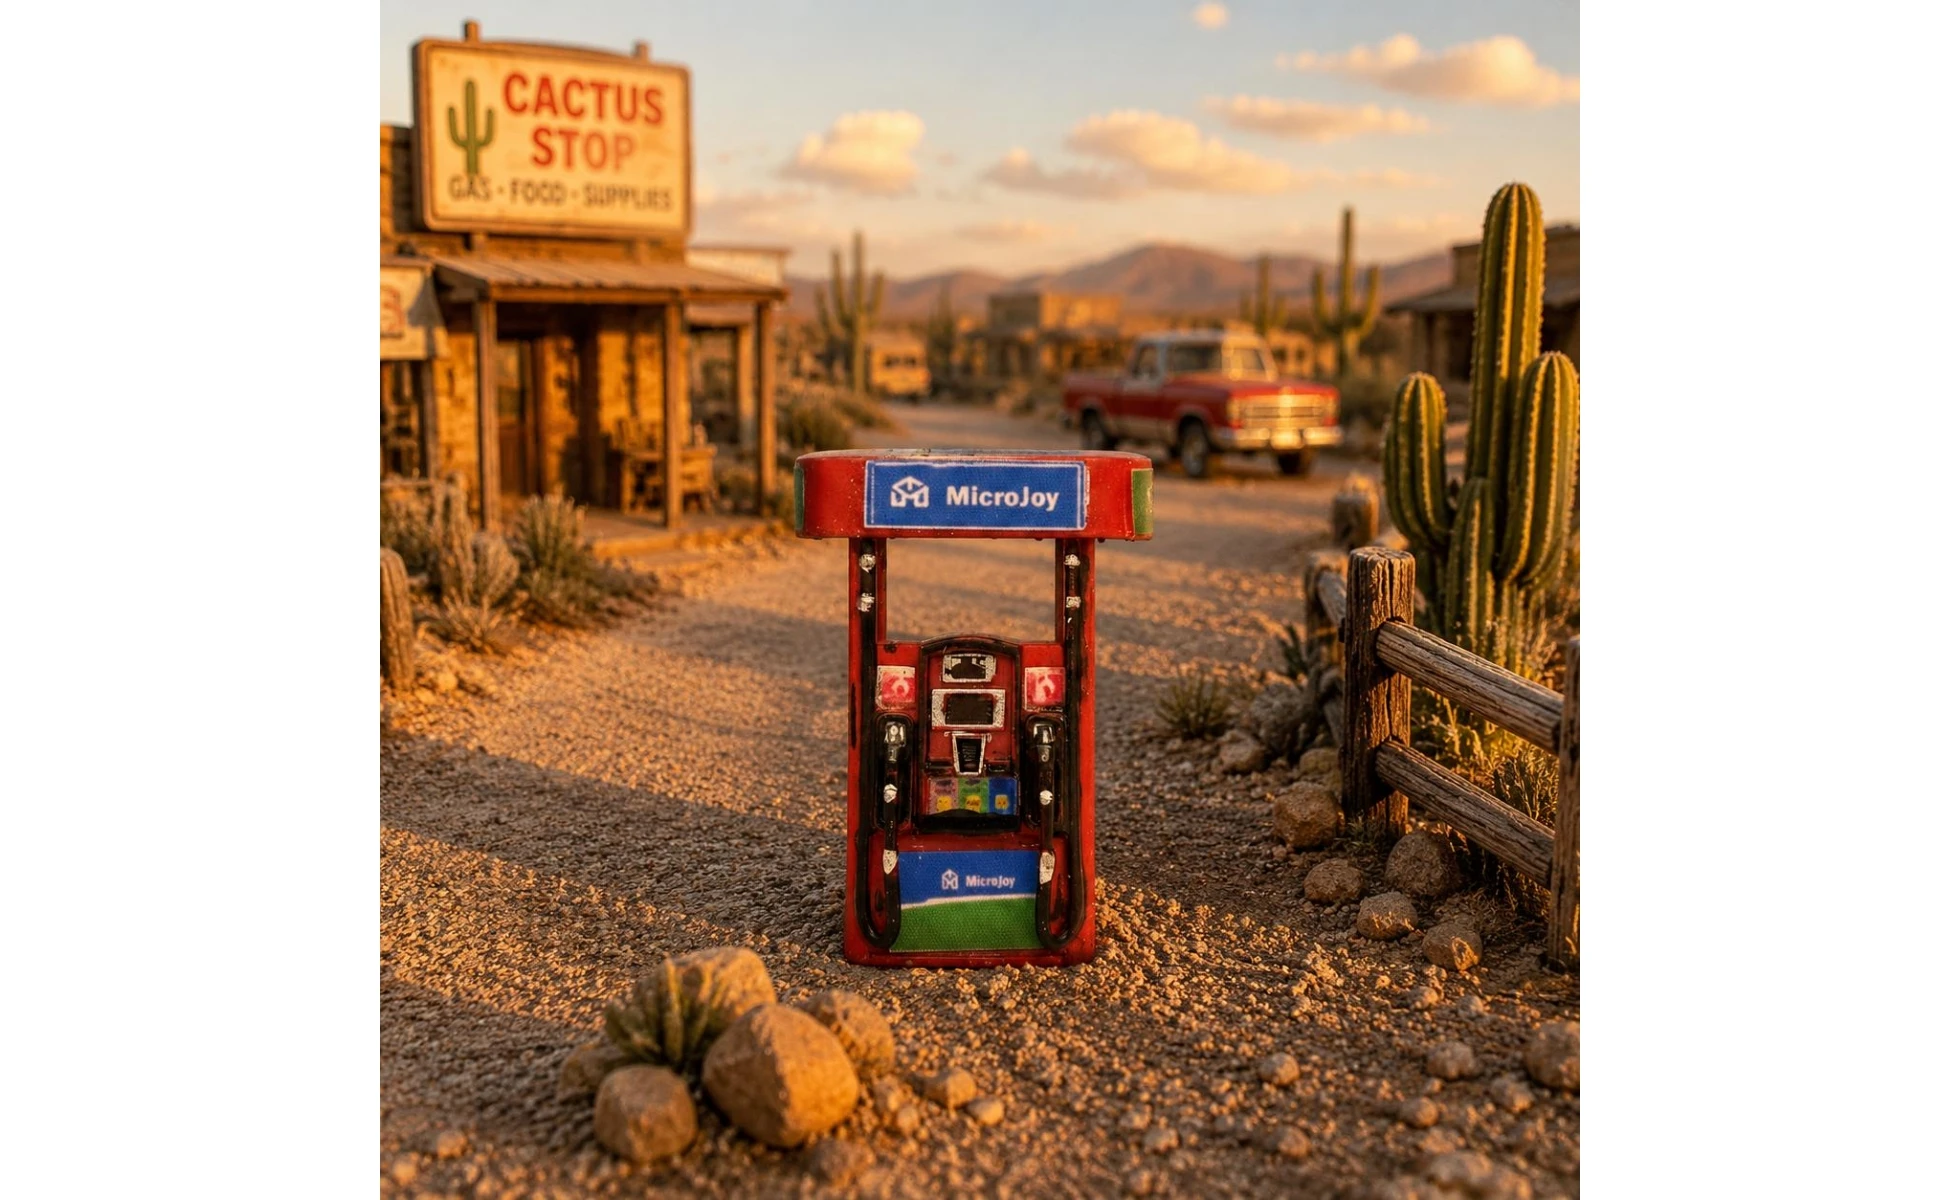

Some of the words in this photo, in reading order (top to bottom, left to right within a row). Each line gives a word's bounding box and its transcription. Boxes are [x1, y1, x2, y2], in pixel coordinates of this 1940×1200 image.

[504, 72, 663, 125] CACTUS
[532, 127, 635, 170] STOP
[449, 175, 491, 202] GAS
[509, 178, 568, 207] FOOD
[583, 183, 671, 211] SUPPLIES
[946, 486, 1059, 511] MicroJoy
[966, 876, 1015, 888] MicroJoy
